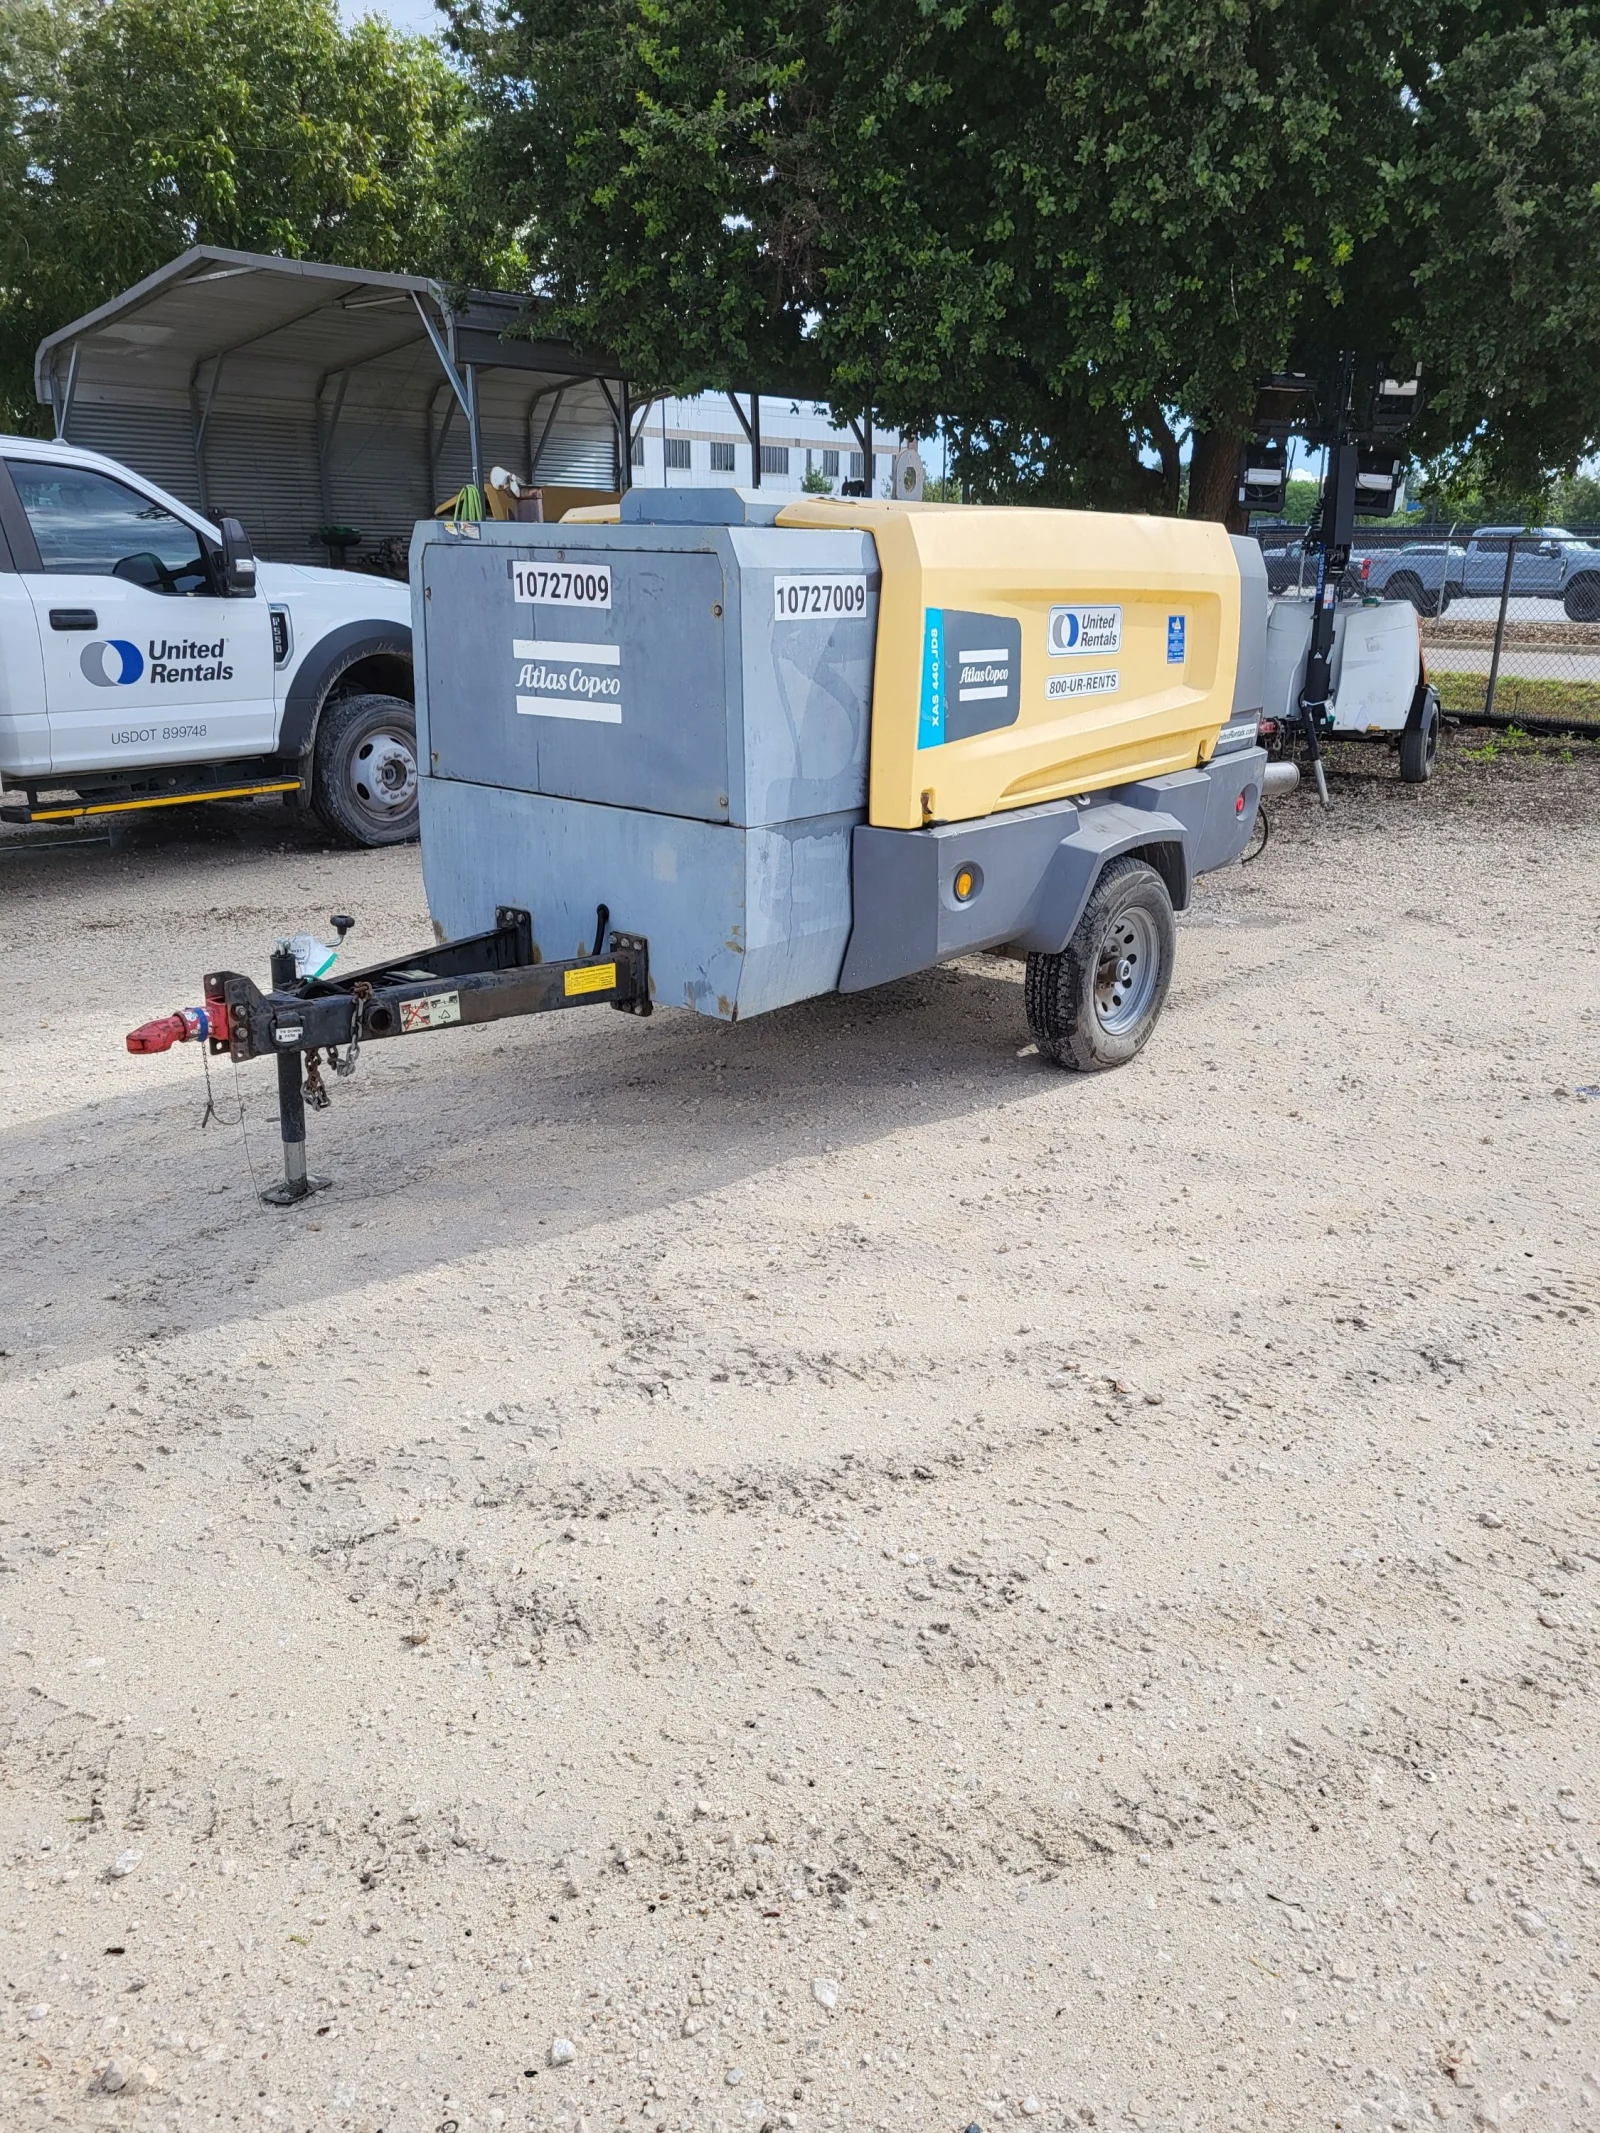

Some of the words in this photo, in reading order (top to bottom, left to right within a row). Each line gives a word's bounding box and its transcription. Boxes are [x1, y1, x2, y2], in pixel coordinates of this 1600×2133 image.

[516, 571, 609, 602] 10727009
[777, 585, 865, 614] 10727009
[1082, 614, 1116, 630] United
[149, 638, 225, 660] United
[1080, 630, 1117, 647] Rentals
[150, 661, 234, 683] Rentals
[515, 664, 567, 690] Atlas
[569, 667, 620, 698] Copco
[959, 666, 984, 683] Atlas
[984, 665, 1008, 684] Copco
[1049, 674, 1117, 695] 800-UR-RENTS
[111, 728, 157, 745] USDOT
[162, 724, 207, 740] 899748
